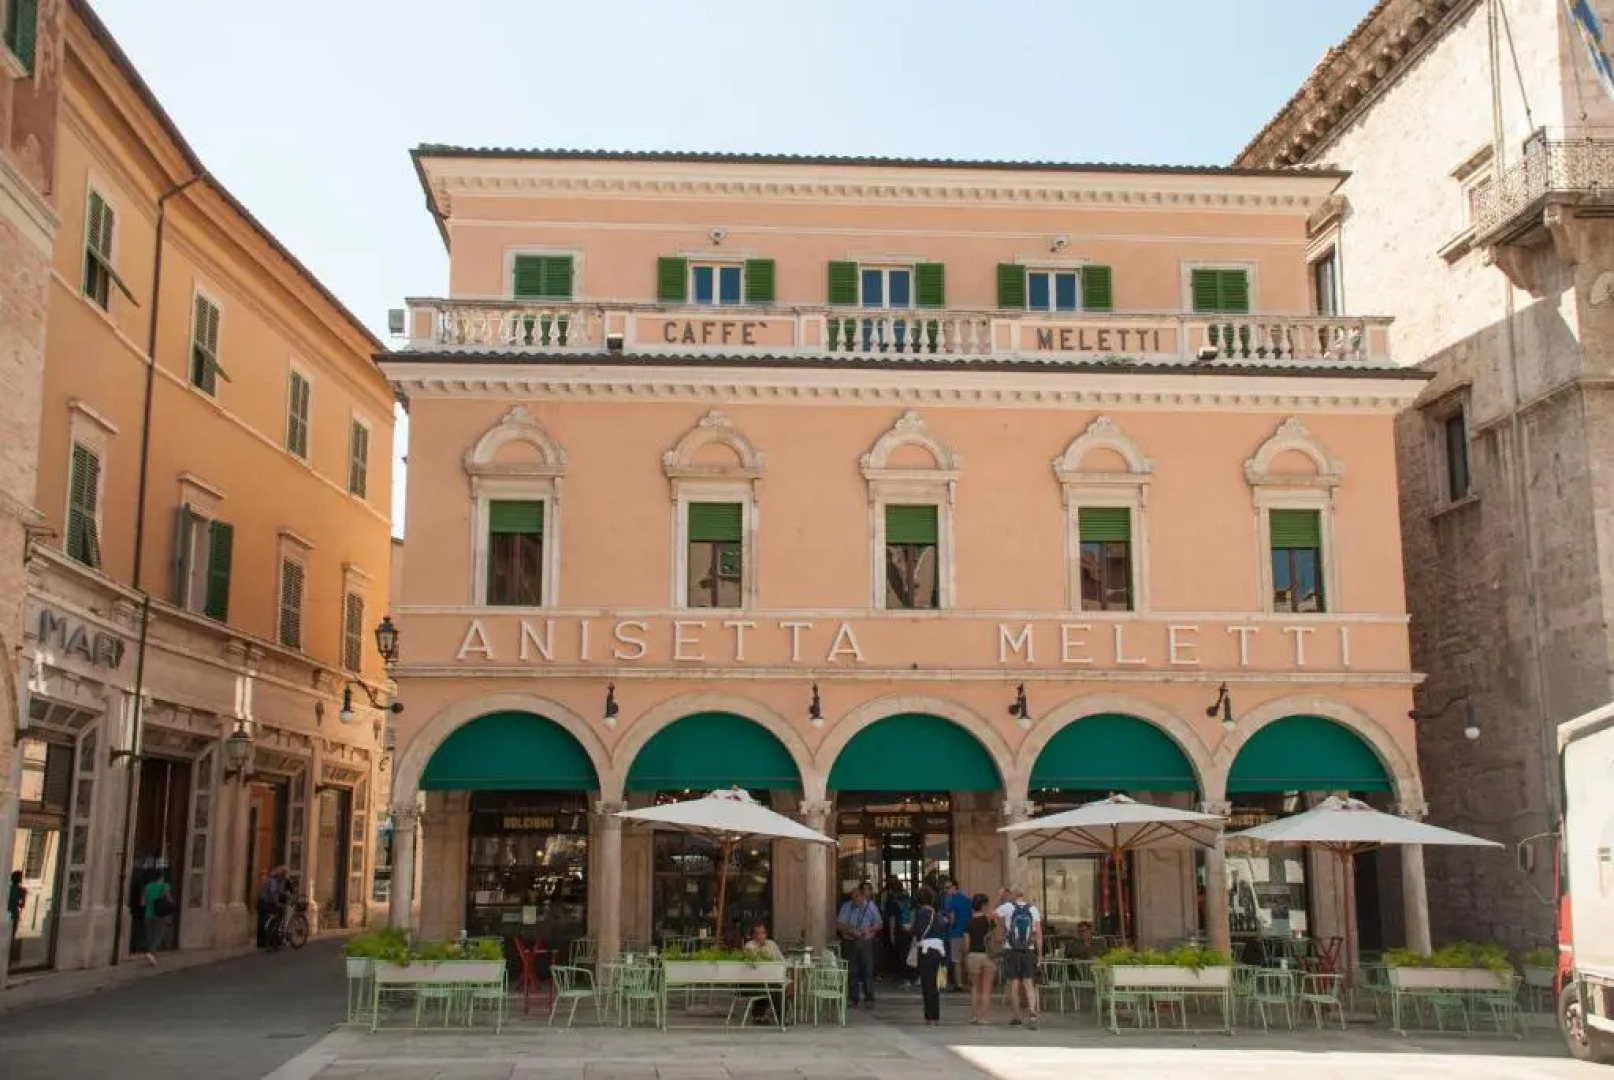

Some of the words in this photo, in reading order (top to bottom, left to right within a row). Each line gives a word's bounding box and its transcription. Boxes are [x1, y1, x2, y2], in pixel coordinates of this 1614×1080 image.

[1037, 327, 1160, 352] MELETTI
[456, 618, 866, 663] ANISETTA
[999, 622, 1352, 666] MELETTI
